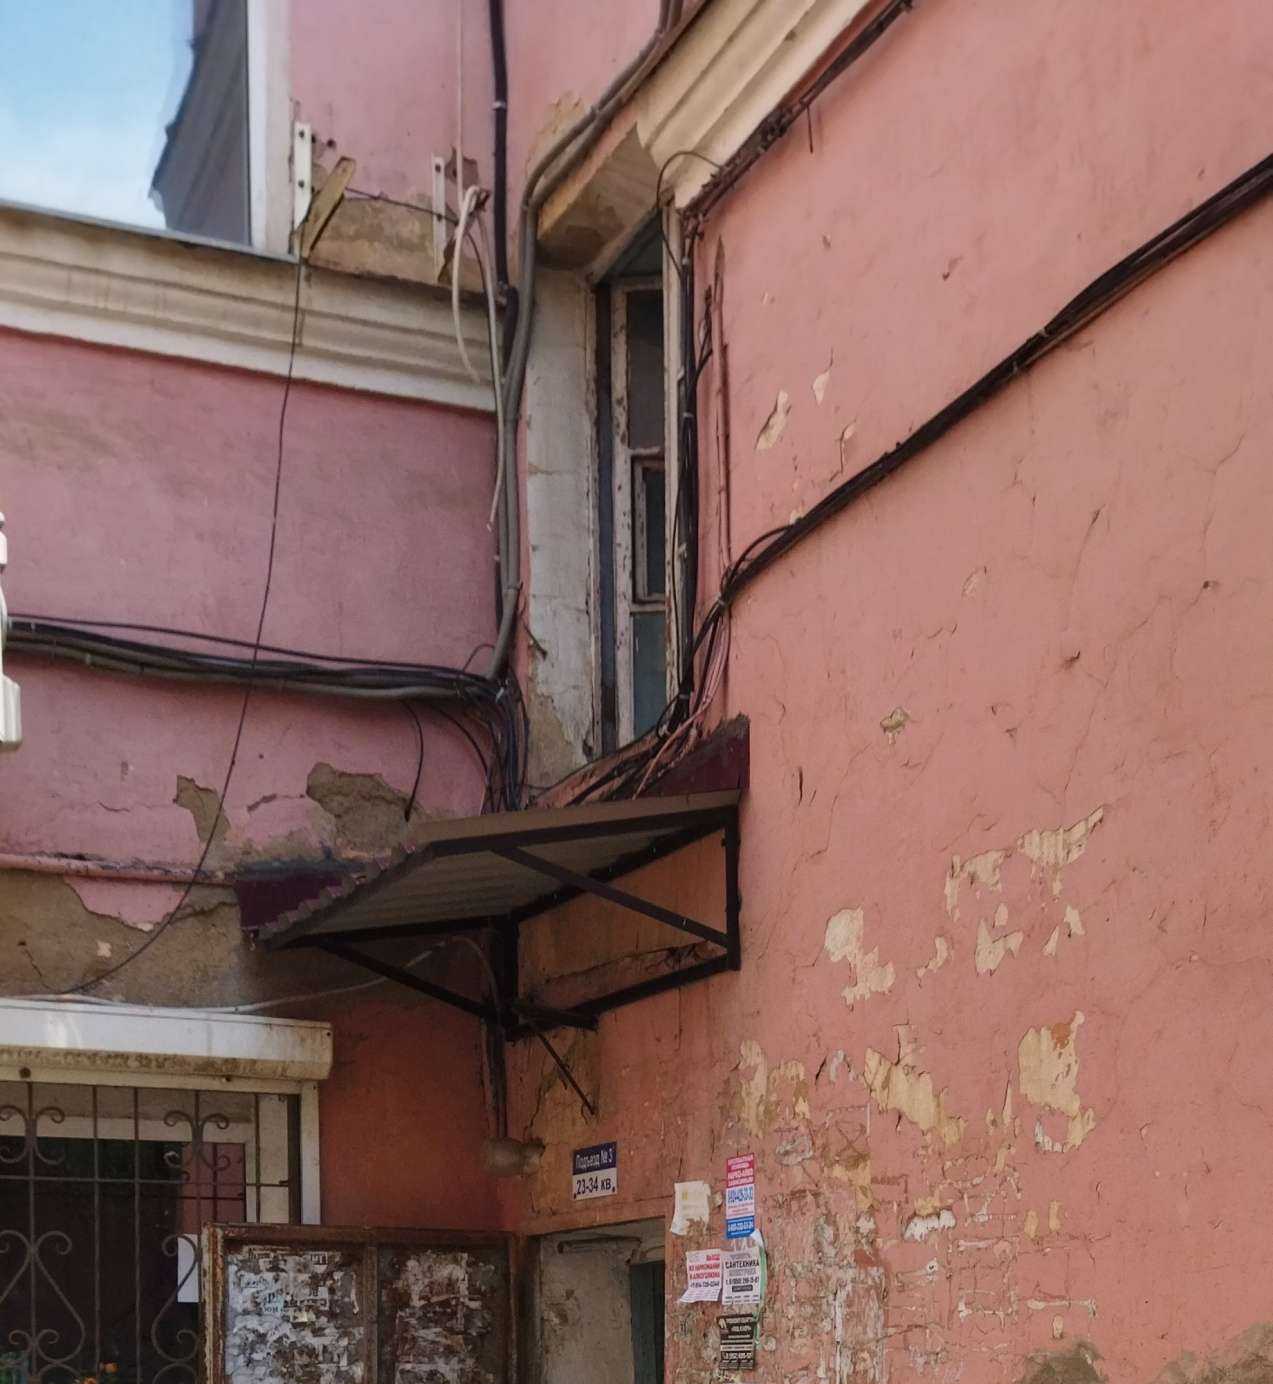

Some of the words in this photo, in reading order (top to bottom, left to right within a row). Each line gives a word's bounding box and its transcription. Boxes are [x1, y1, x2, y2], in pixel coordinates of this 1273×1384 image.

[576, 1154, 600, 1170] Подъезд
[576, 1176, 599, 1194] 23-34
[725, 1259, 760, 1269] САНТЕХНИКА
